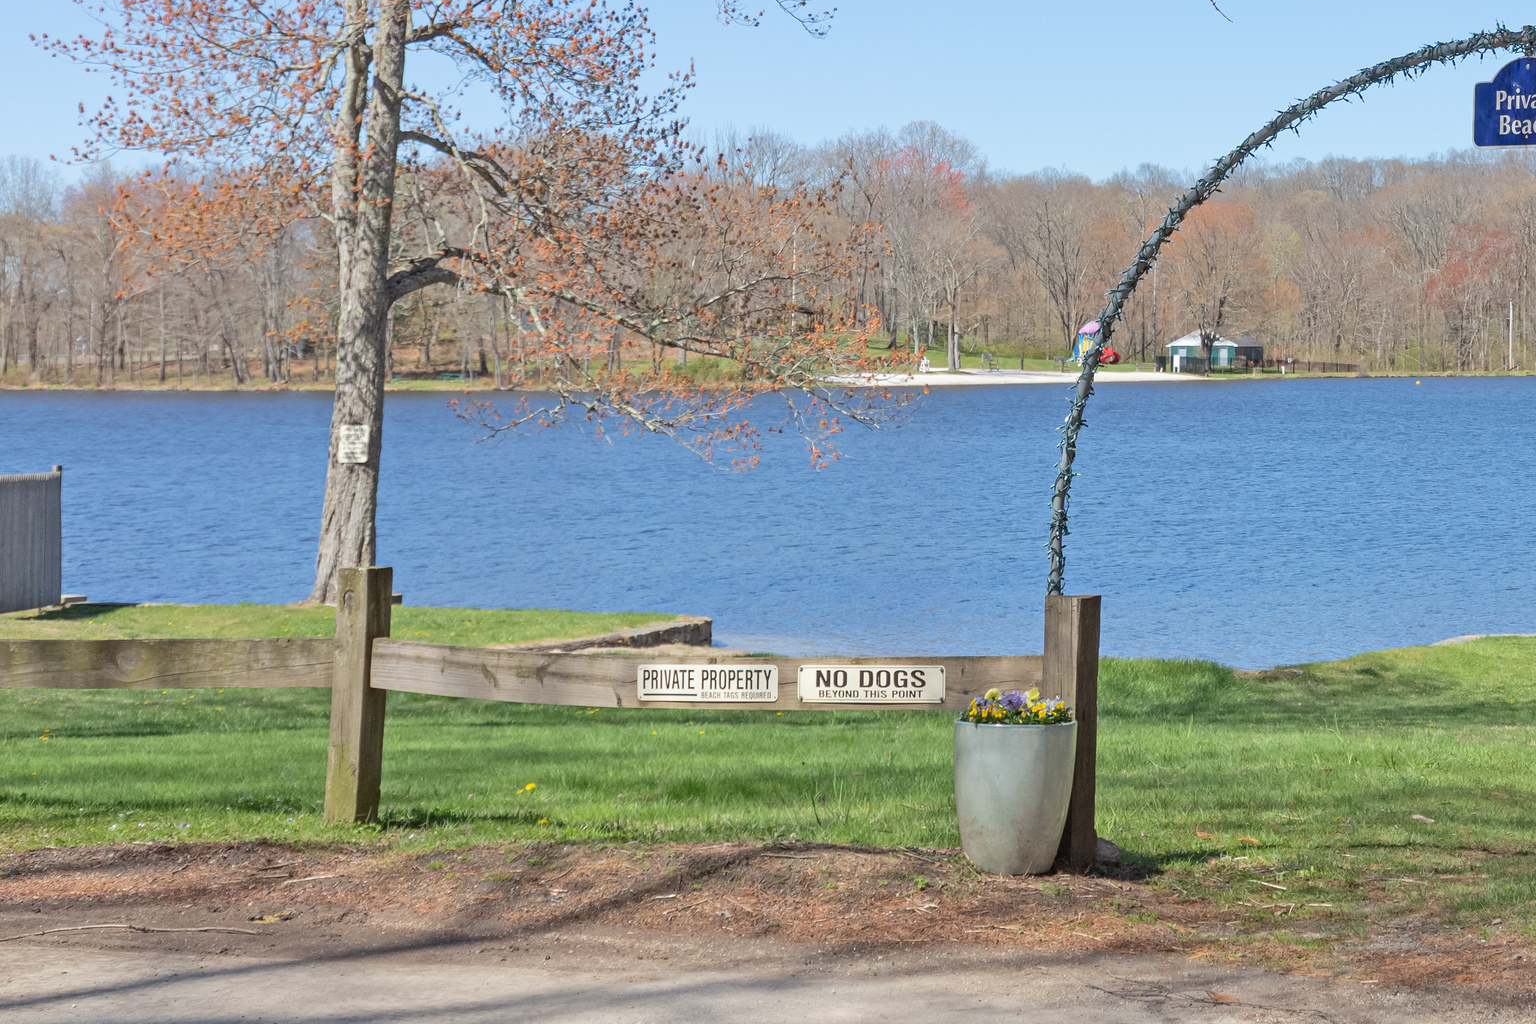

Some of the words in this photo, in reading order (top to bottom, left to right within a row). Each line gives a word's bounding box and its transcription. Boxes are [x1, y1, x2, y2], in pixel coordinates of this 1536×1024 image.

[643, 669, 695, 690] PRIVATE
[701, 669, 772, 690] PROPERTY
[815, 670, 848, 688] NO
[859, 670, 926, 688] DOGS
[700, 691, 721, 700] BEACH
[723, 692, 739, 700] TAGS
[740, 691, 772, 700] REQUIRED
[818, 690, 859, 699] BEYOND
[891, 690, 924, 699] POINT
